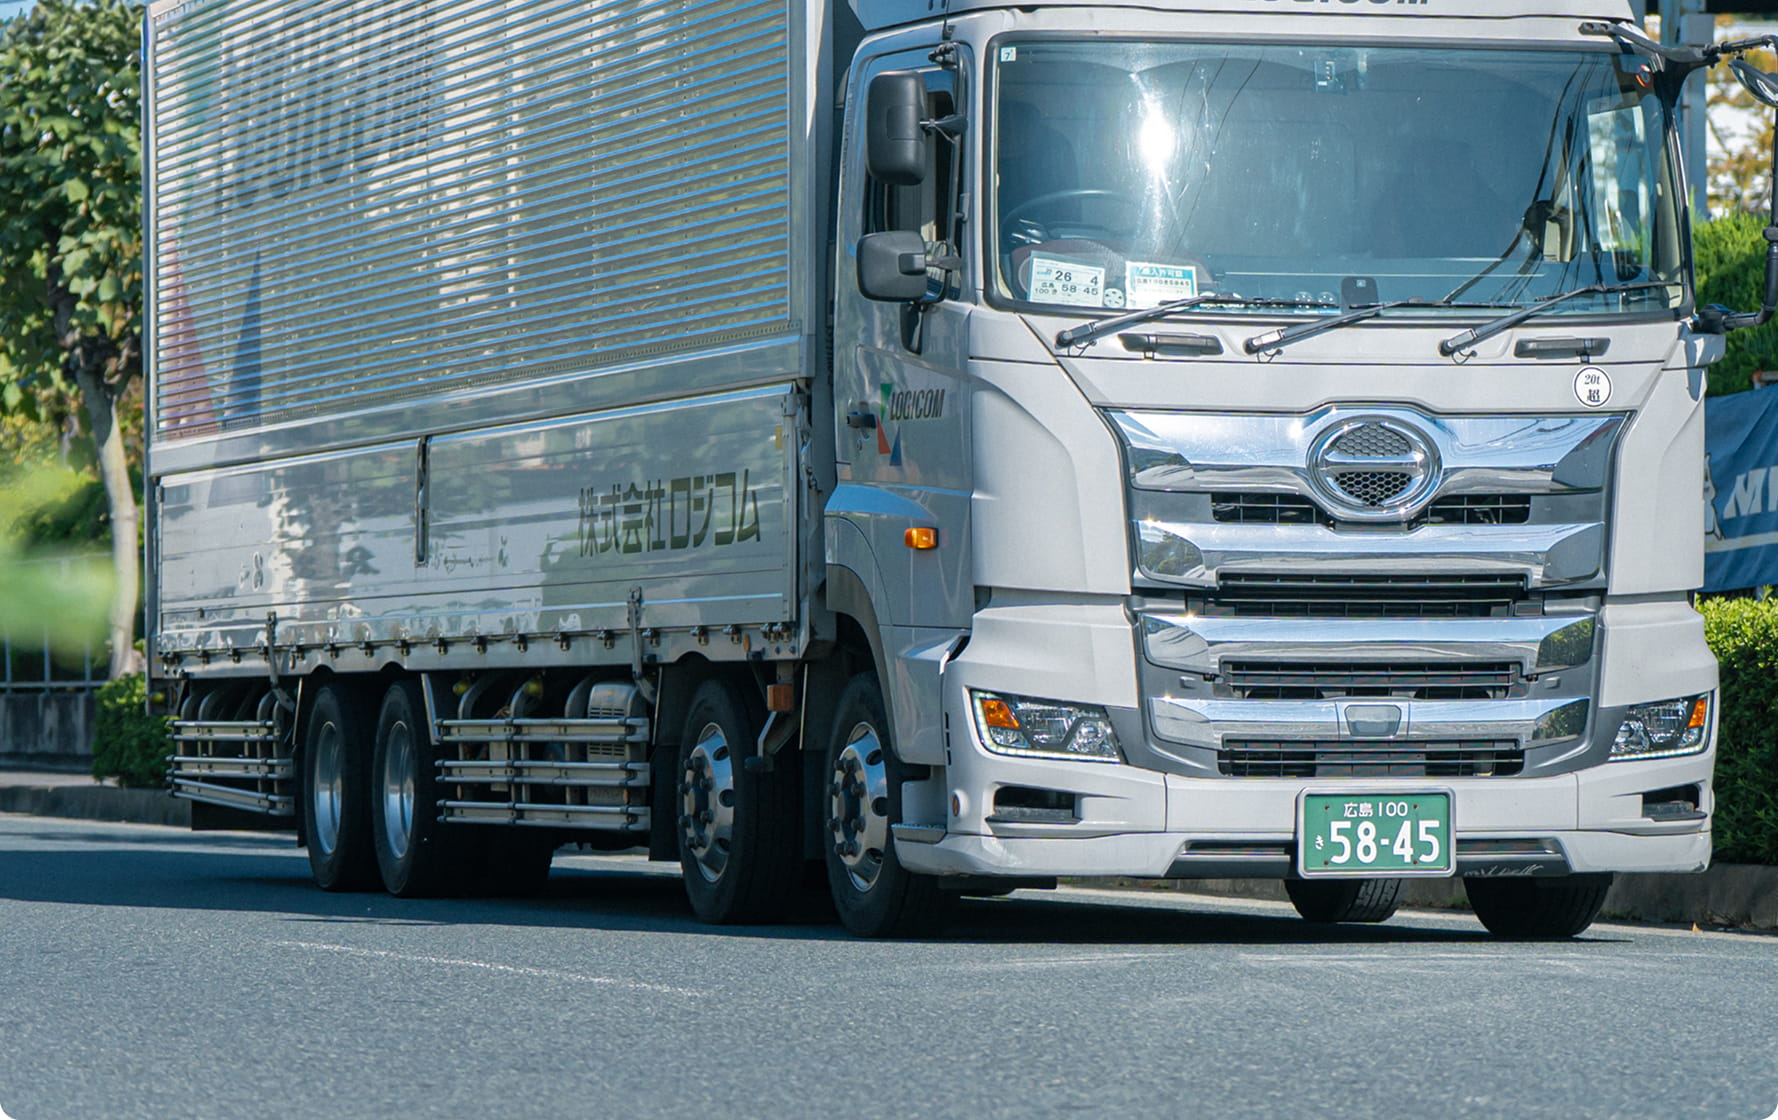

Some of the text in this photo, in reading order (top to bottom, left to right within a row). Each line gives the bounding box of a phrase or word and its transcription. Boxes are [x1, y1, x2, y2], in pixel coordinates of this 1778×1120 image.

[1055, 270, 1072, 282] 26
[1090, 275, 1099, 286] 4
[1061, 283, 1077, 293] 58
[1083, 286, 1099, 296] 45
[1584, 373, 1601, 385] 20t
[890, 388, 946, 421] LOGICOM
[577, 467, 762, 558] 株式会社ロジコム
[1343, 801, 1409, 818] 広島 100
[1314, 820, 1440, 864] き 58-45
